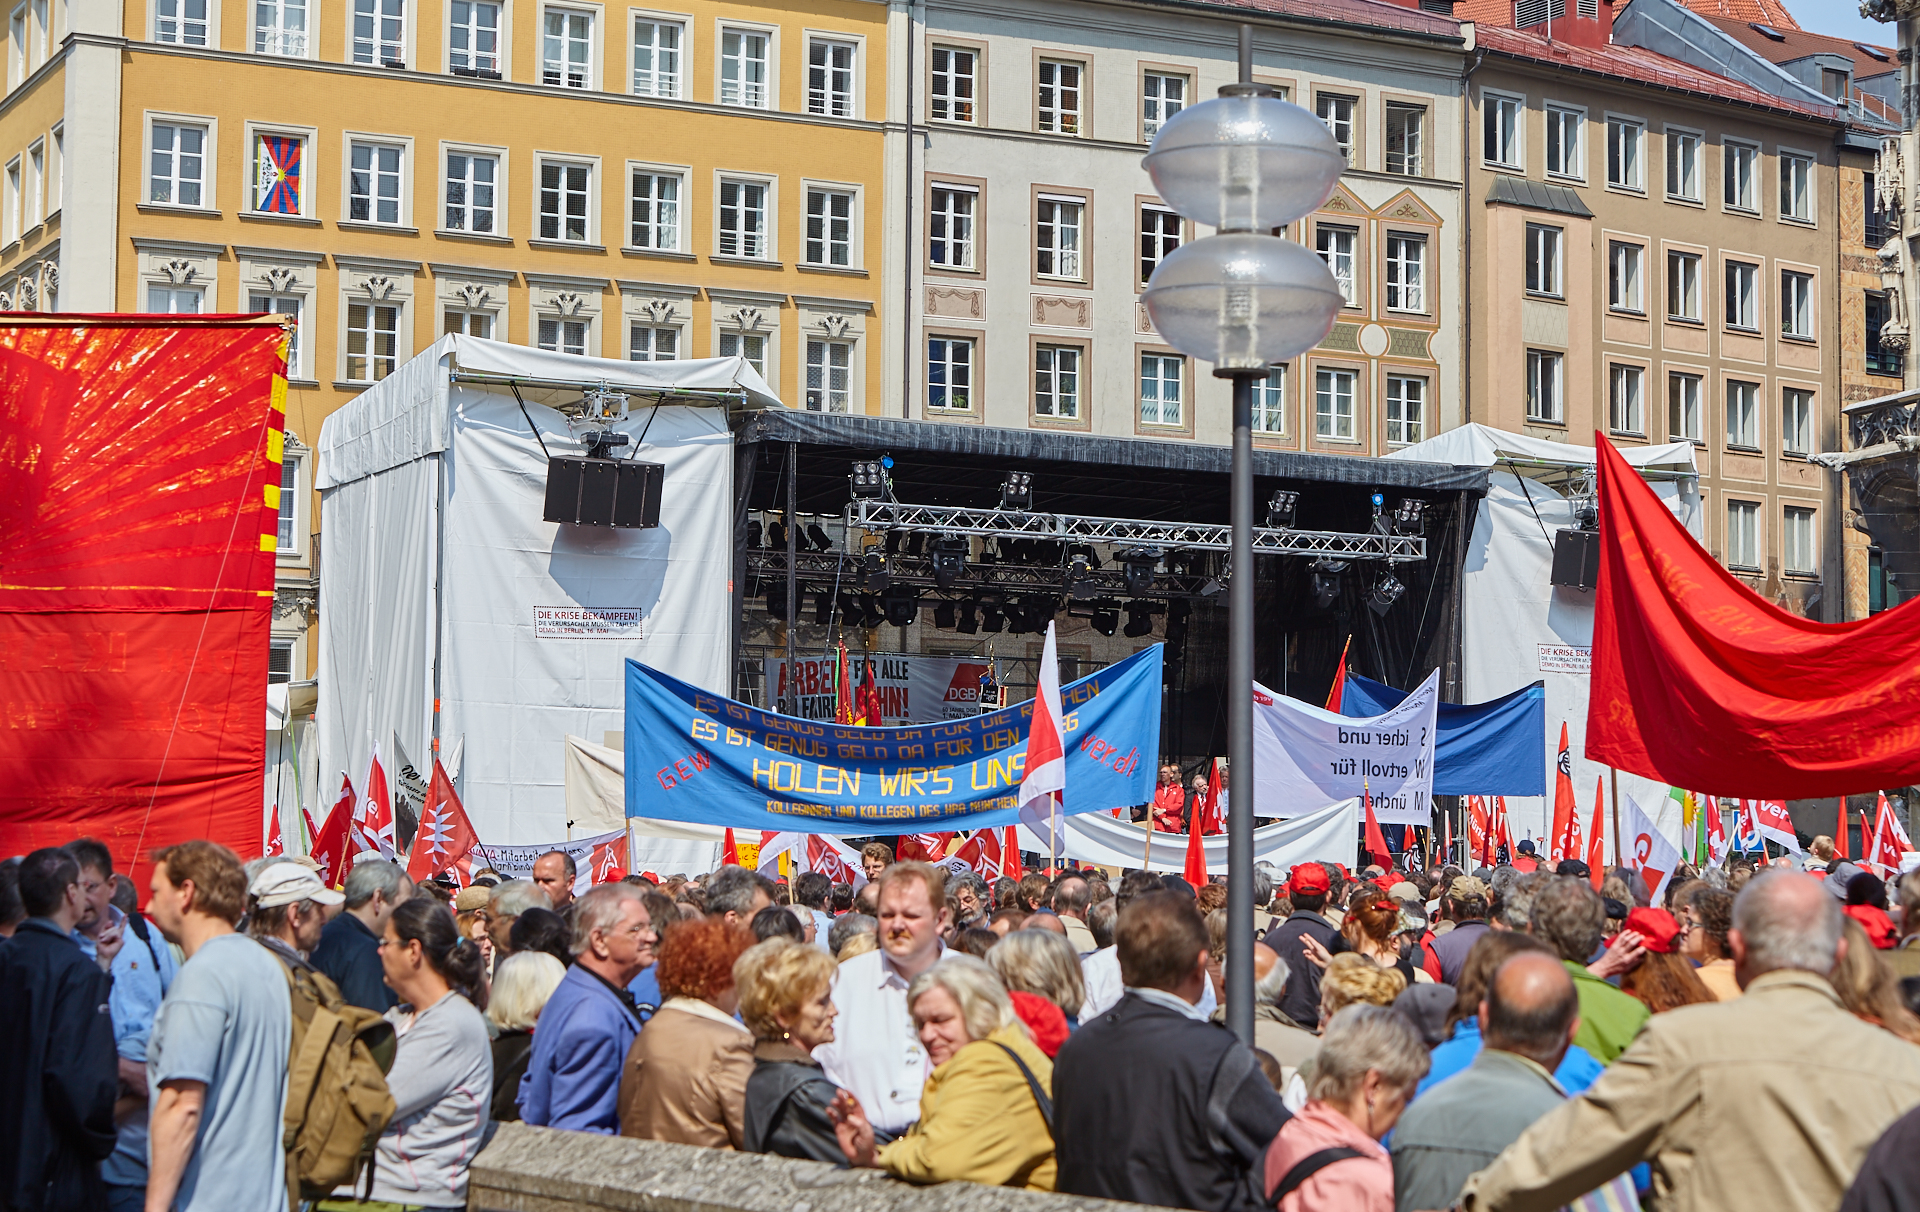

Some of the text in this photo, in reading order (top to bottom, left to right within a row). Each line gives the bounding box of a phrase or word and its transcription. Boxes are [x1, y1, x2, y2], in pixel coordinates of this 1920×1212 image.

[538, 610, 638, 621] DIE KRISE BEKÄMPFEN!
[882, 659, 908, 680] ALLE
[695, 694, 720, 714] ES
[726, 704, 752, 723] IST
[950, 687, 977, 701] DGB
[691, 718, 1020, 759] ES IST GENUG GELD DA FÜR DEN
[1080, 732, 1140, 777] ver.di
[656, 751, 710, 790] GEW
[752, 758, 860, 796] HOLEN
[880, 765, 954, 796] WIR'S
[766, 795, 1018, 818] KOLLEGINNEN UND KOLLEGEN DES HPA MÜNCHEN
